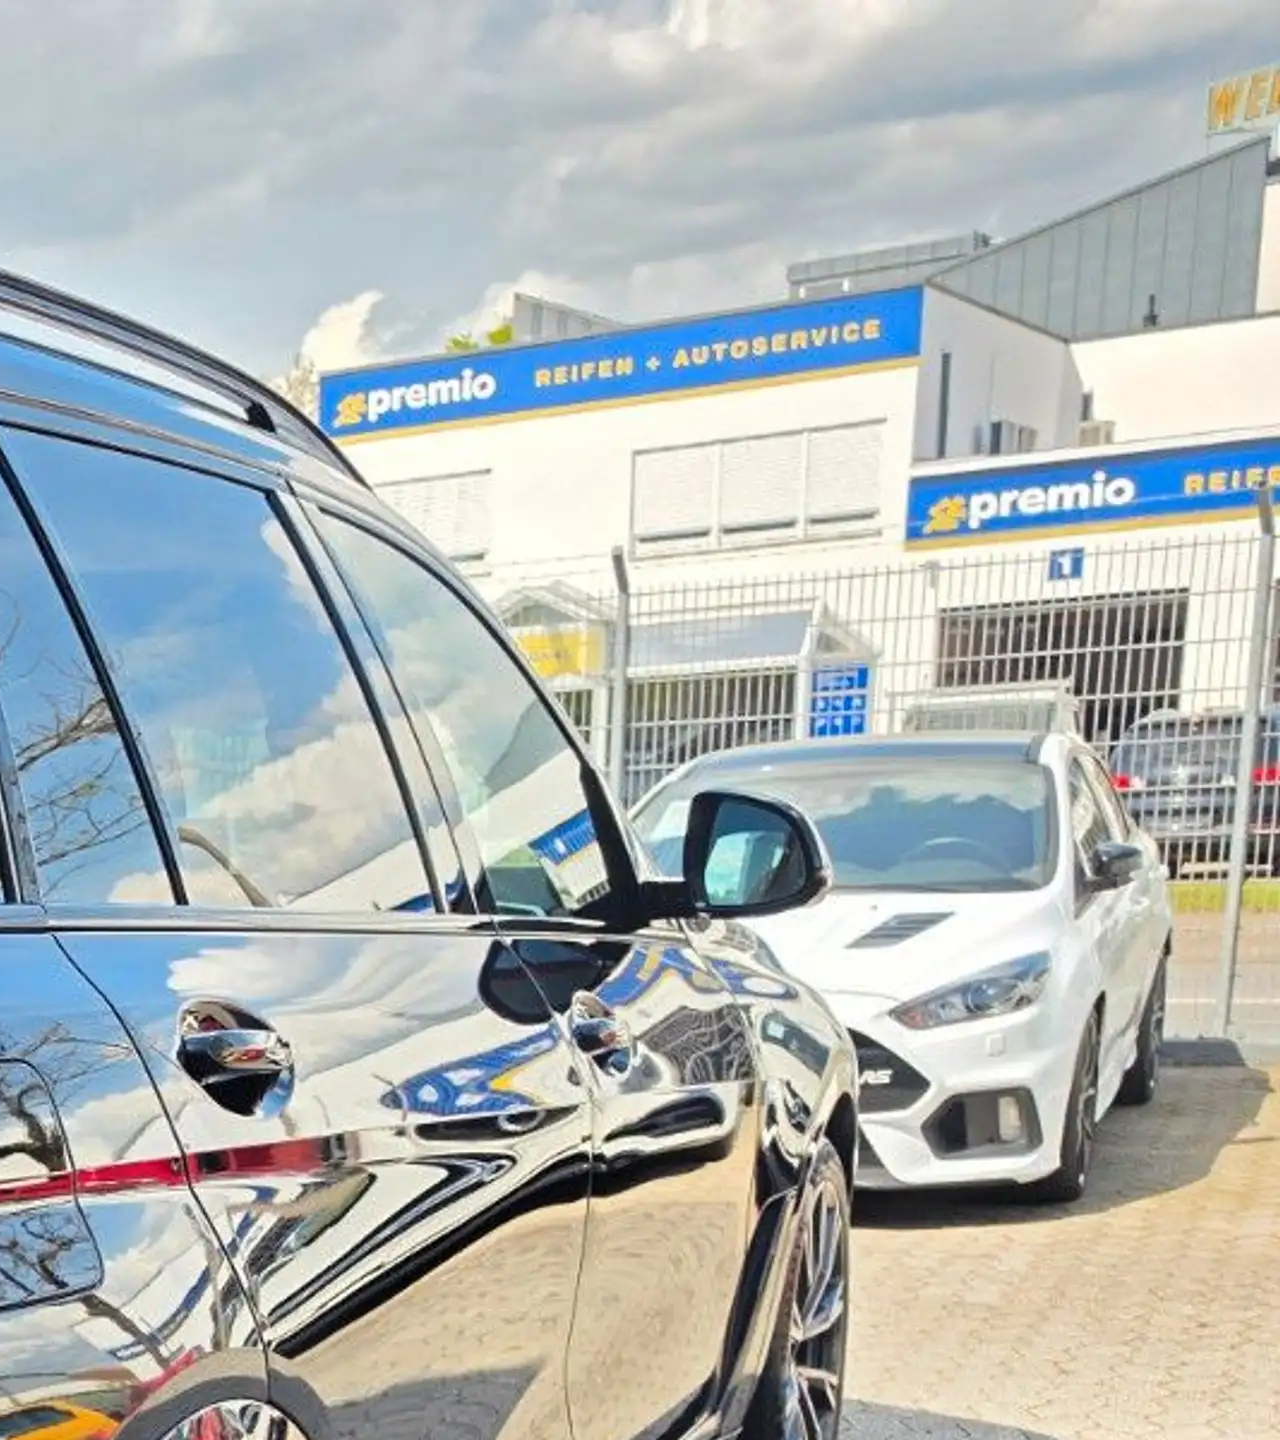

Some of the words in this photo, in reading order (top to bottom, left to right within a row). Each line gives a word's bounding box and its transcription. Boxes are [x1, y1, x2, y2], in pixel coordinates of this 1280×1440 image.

[535, 357, 634, 387] REIFEN
[673, 319, 881, 368] AUTOSERVICE
[367, 367, 497, 423] premio
[968, 470, 1136, 530] premio
[1058, 552, 1072, 578] 1
